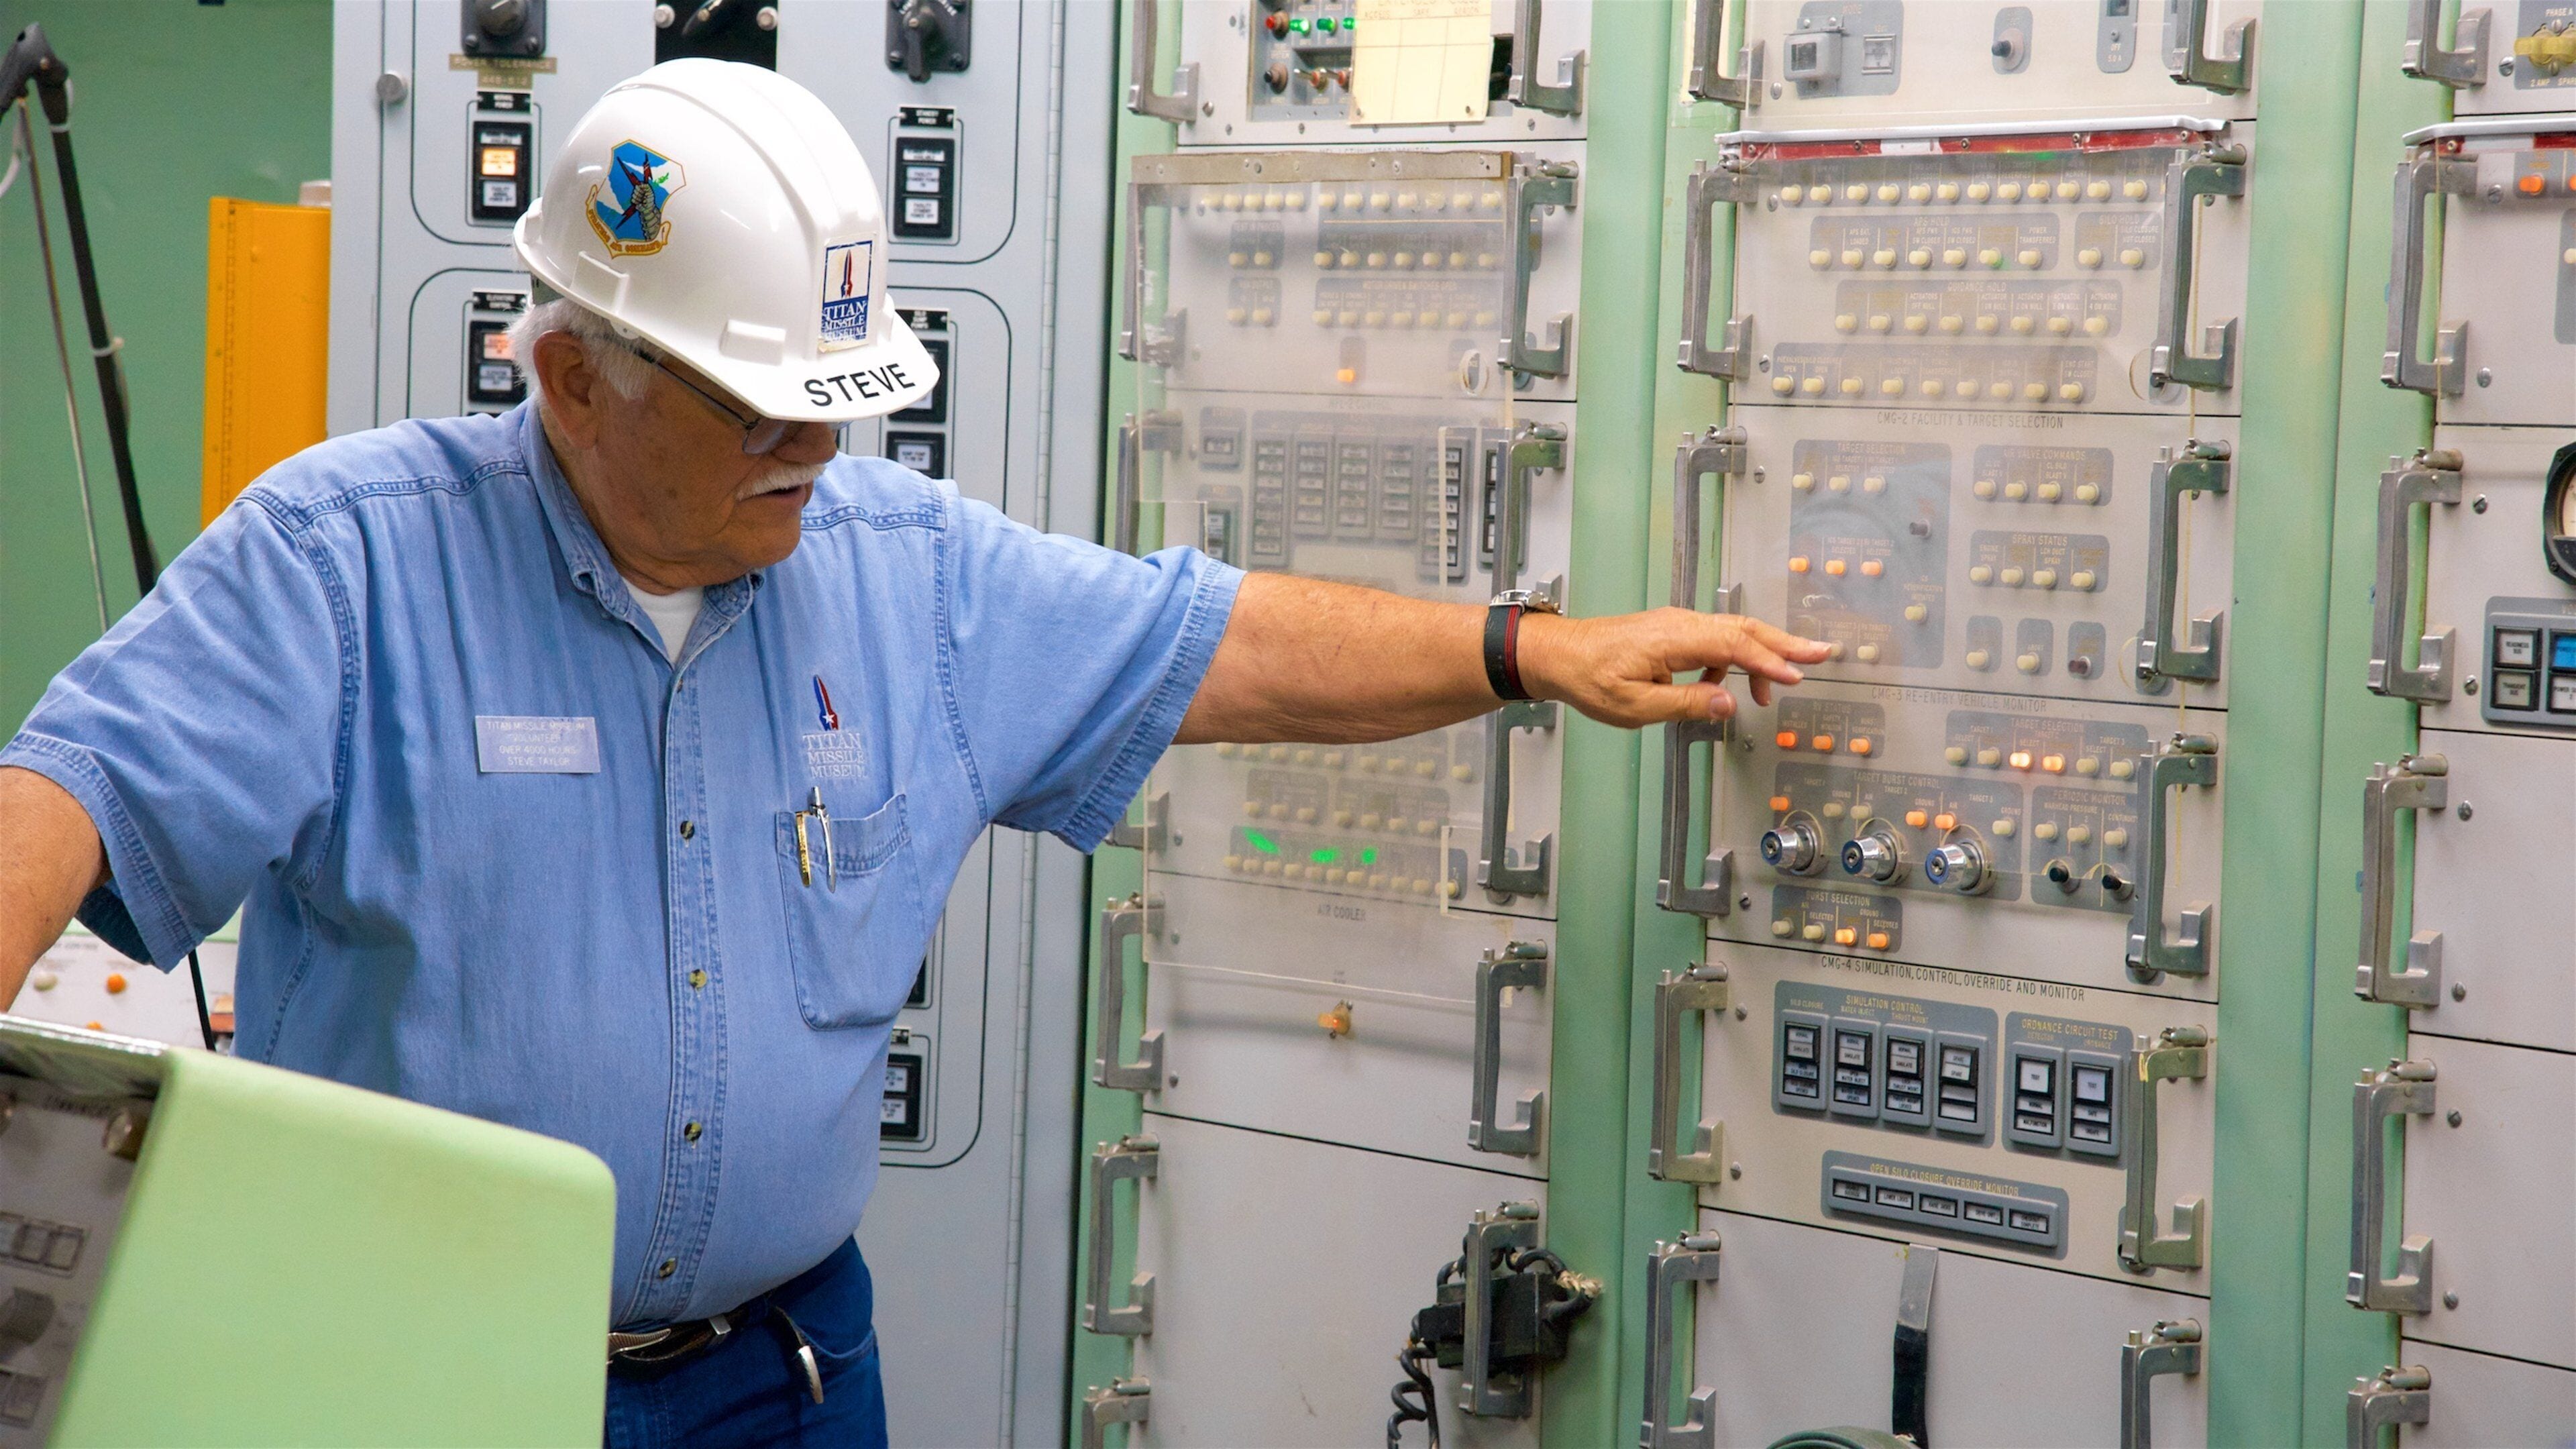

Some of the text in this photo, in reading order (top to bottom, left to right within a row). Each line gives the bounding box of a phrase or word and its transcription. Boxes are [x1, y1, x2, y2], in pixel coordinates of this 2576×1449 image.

[1947, 281, 1984, 292] GUIDANCE
[824, 301, 867, 321] TITAN
[822, 314, 865, 332] MISSILE
[804, 362, 916, 407] STEVE
[1877, 412, 1907, 425] CMG-2
[1911, 413, 1955, 426] FACILITY
[1968, 414, 2004, 427] TARGET
[2008, 415, 2063, 429] SELECTION
[1837, 443, 1905, 454] TARGET SELECTION
[2012, 535, 2068, 546] SPRAY STATUS
[2044, 557, 2061, 565] SPRAY
[1871, 688, 2047, 712] CMG-3 RE-ENTRY VEHICLE MONITOR
[1824, 702, 1852, 714] STATUS
[487, 721, 511, 730] TITAN
[513, 722, 547, 731] MISSILE
[2012, 718, 2084, 733] TARGET SELECTION
[802, 733, 862, 751] TITAN
[2019, 739, 2039, 747] SELECT
[2099, 736, 2121, 745] TARGET
[499, 745, 521, 754] OVER
[548, 745, 576, 755] HOURS
[2086, 745, 2107, 753] SELECT
[508, 757, 570, 766] STEVE TAYLOR
[807, 751, 866, 765] MISSILE
[810, 764, 867, 779] MUSEUM
[1854, 771, 1941, 789] TARGET BURST CONTROL
[1831, 790, 1851, 798] GROUND
[1884, 786, 1902, 795] TARGET
[1915, 798, 1935, 806] GROUND
[1969, 794, 1989, 802] TARGET
[2053, 792, 2126, 806] PERIODIC MONITOR
[2000, 807, 2021, 816] GROUND
[2070, 804, 2098, 814] PRESSURE
[1806, 890, 1871, 907] BURST SELECTION
[1334, 906, 1366, 922] COOLER
[1809, 911, 1834, 921] SELECTED
[1821, 955, 1851, 970] CMG-4
[1964, 973, 2012, 993] OVERRIDE
[2015, 980, 2037, 996] AND
[2039, 983, 2085, 1002] MONITOR
[1845, 994, 1924, 1015] SIMULATION CONTROL
[1840, 1006, 1876, 1016] WATER INJECT
[1892, 1012, 1911, 1022] THRUST
[2021, 1018, 2118, 1040] ORDNANCE CIRCUIT TEST
[1896, 1061, 1913, 1069] SIMULATE
[2023, 1119, 2047, 1128] MALFUNCTION
[1870, 1163, 2019, 1197] OPEN SILO CLOSURE OVERRIDE MONITOR
